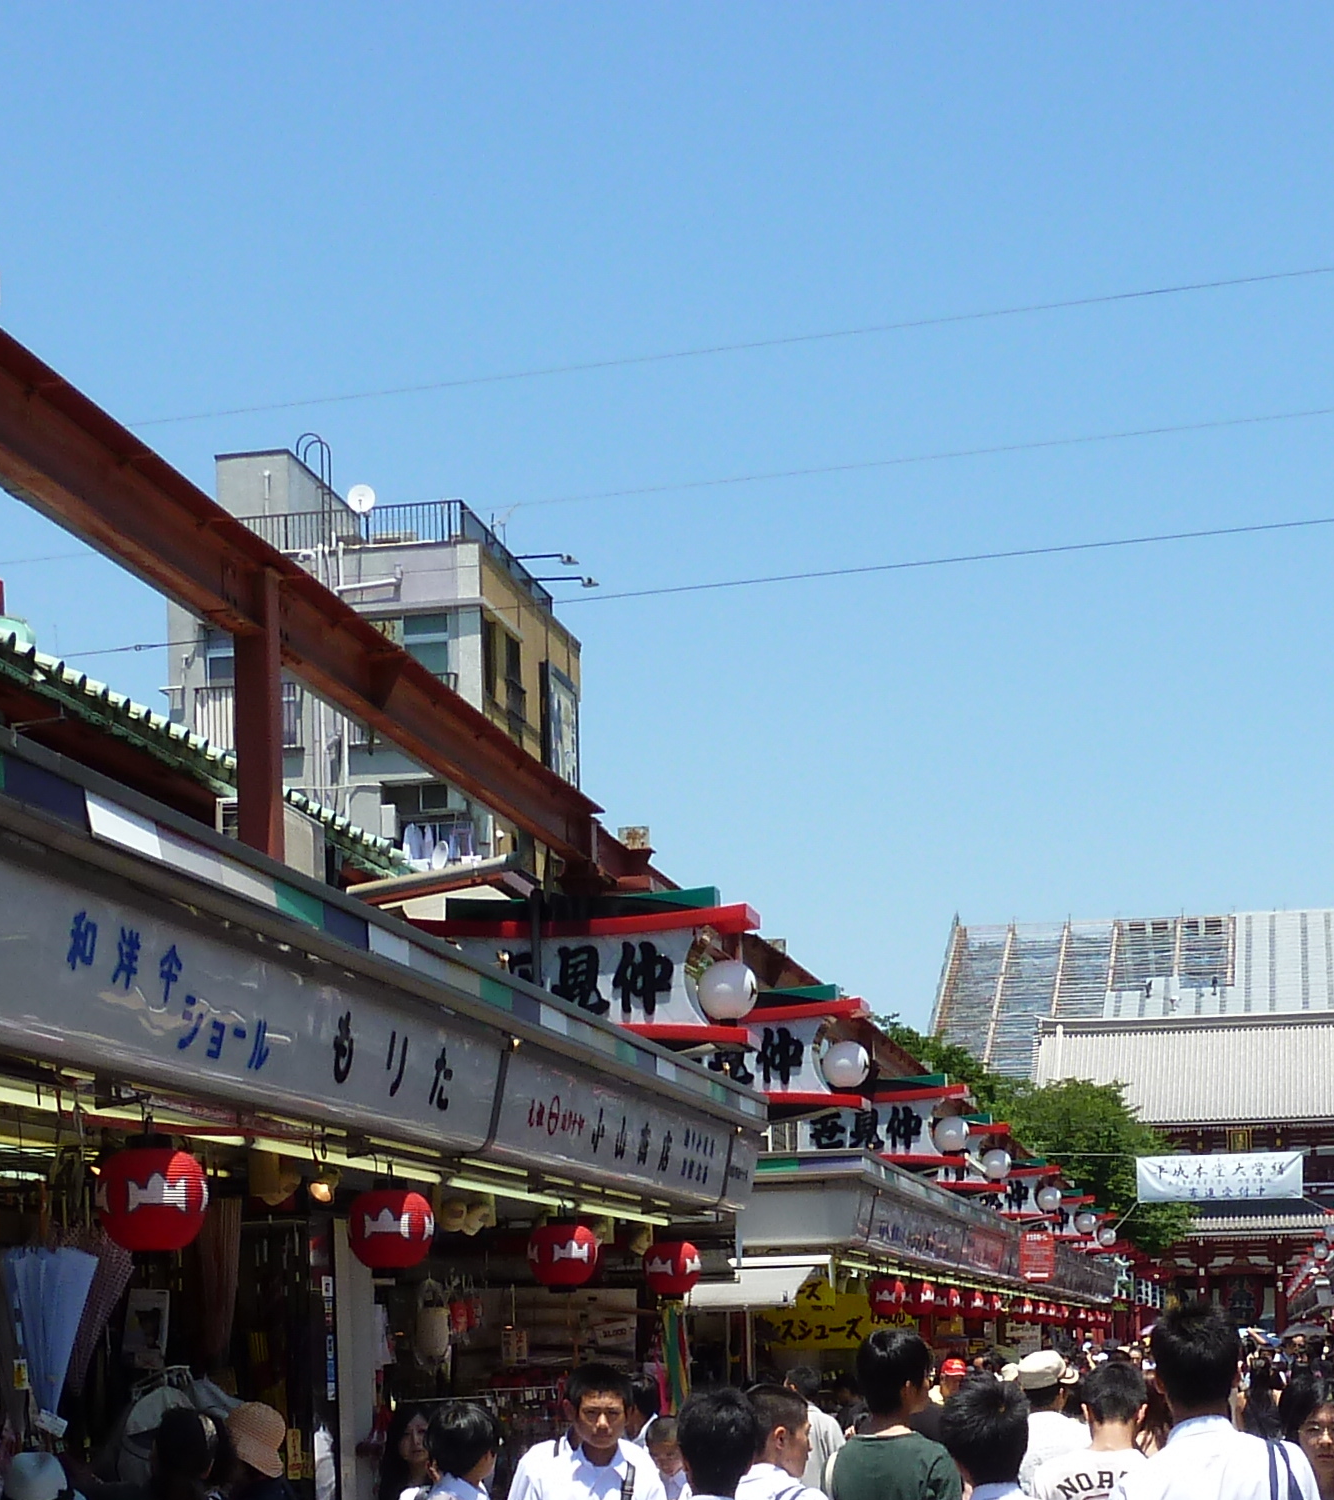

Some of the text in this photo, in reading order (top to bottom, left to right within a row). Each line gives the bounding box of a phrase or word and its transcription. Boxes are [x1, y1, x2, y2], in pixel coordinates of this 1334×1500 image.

[177, 995, 270, 1070] ショール
[331, 1009, 455, 1112] もりた
